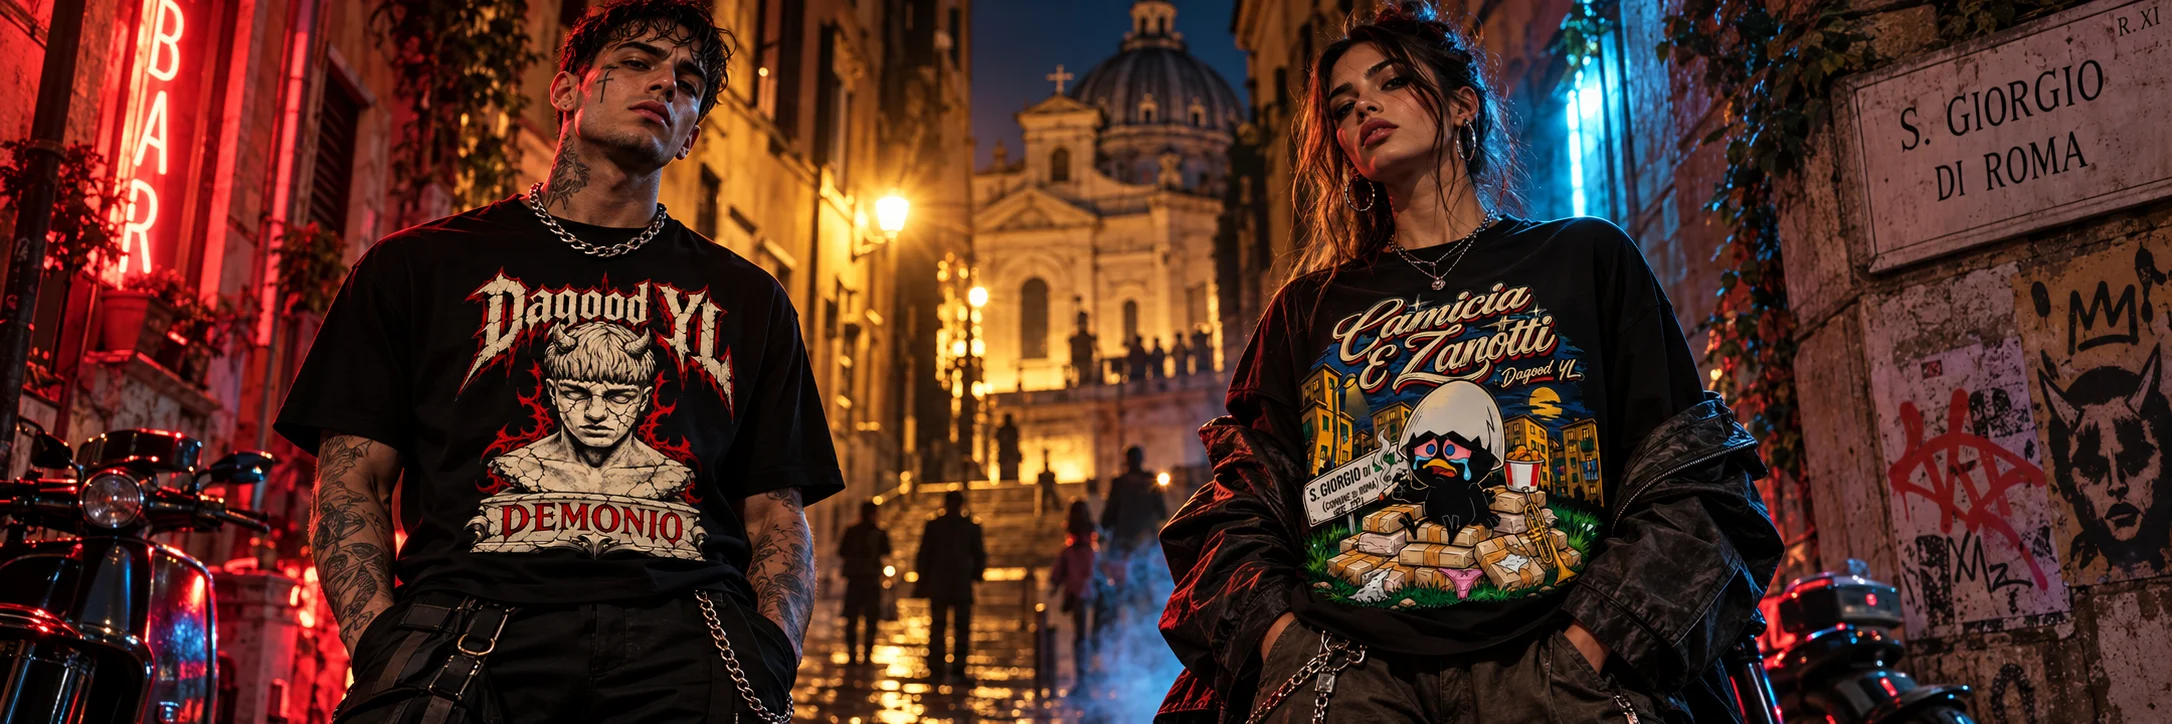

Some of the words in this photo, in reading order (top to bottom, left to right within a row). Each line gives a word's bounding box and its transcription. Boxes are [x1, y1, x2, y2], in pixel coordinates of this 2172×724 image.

[2117, 16, 2137, 37] R.
[2139, 6, 2161, 30] XI
[118, 0, 184, 274] BAR
[1900, 106, 1931, 152] S.
[1946, 59, 2104, 137] GIORGIO
[1934, 160, 1966, 202] DI
[1983, 131, 2089, 191] ROMA
[457, 267, 651, 399] Dagood
[654, 283, 734, 418] YL
[1332, 282, 1534, 364] Camicia
[1392, 315, 1560, 394] Zanotti
[1500, 359, 1555, 388] Dagood
[1559, 358, 1581, 383] YL
[1309, 487, 1320, 502] S.
[1320, 467, 1360, 497] GIORGIO
[1362, 464, 1372, 478] DI
[501, 502, 683, 545] DEMONIO
